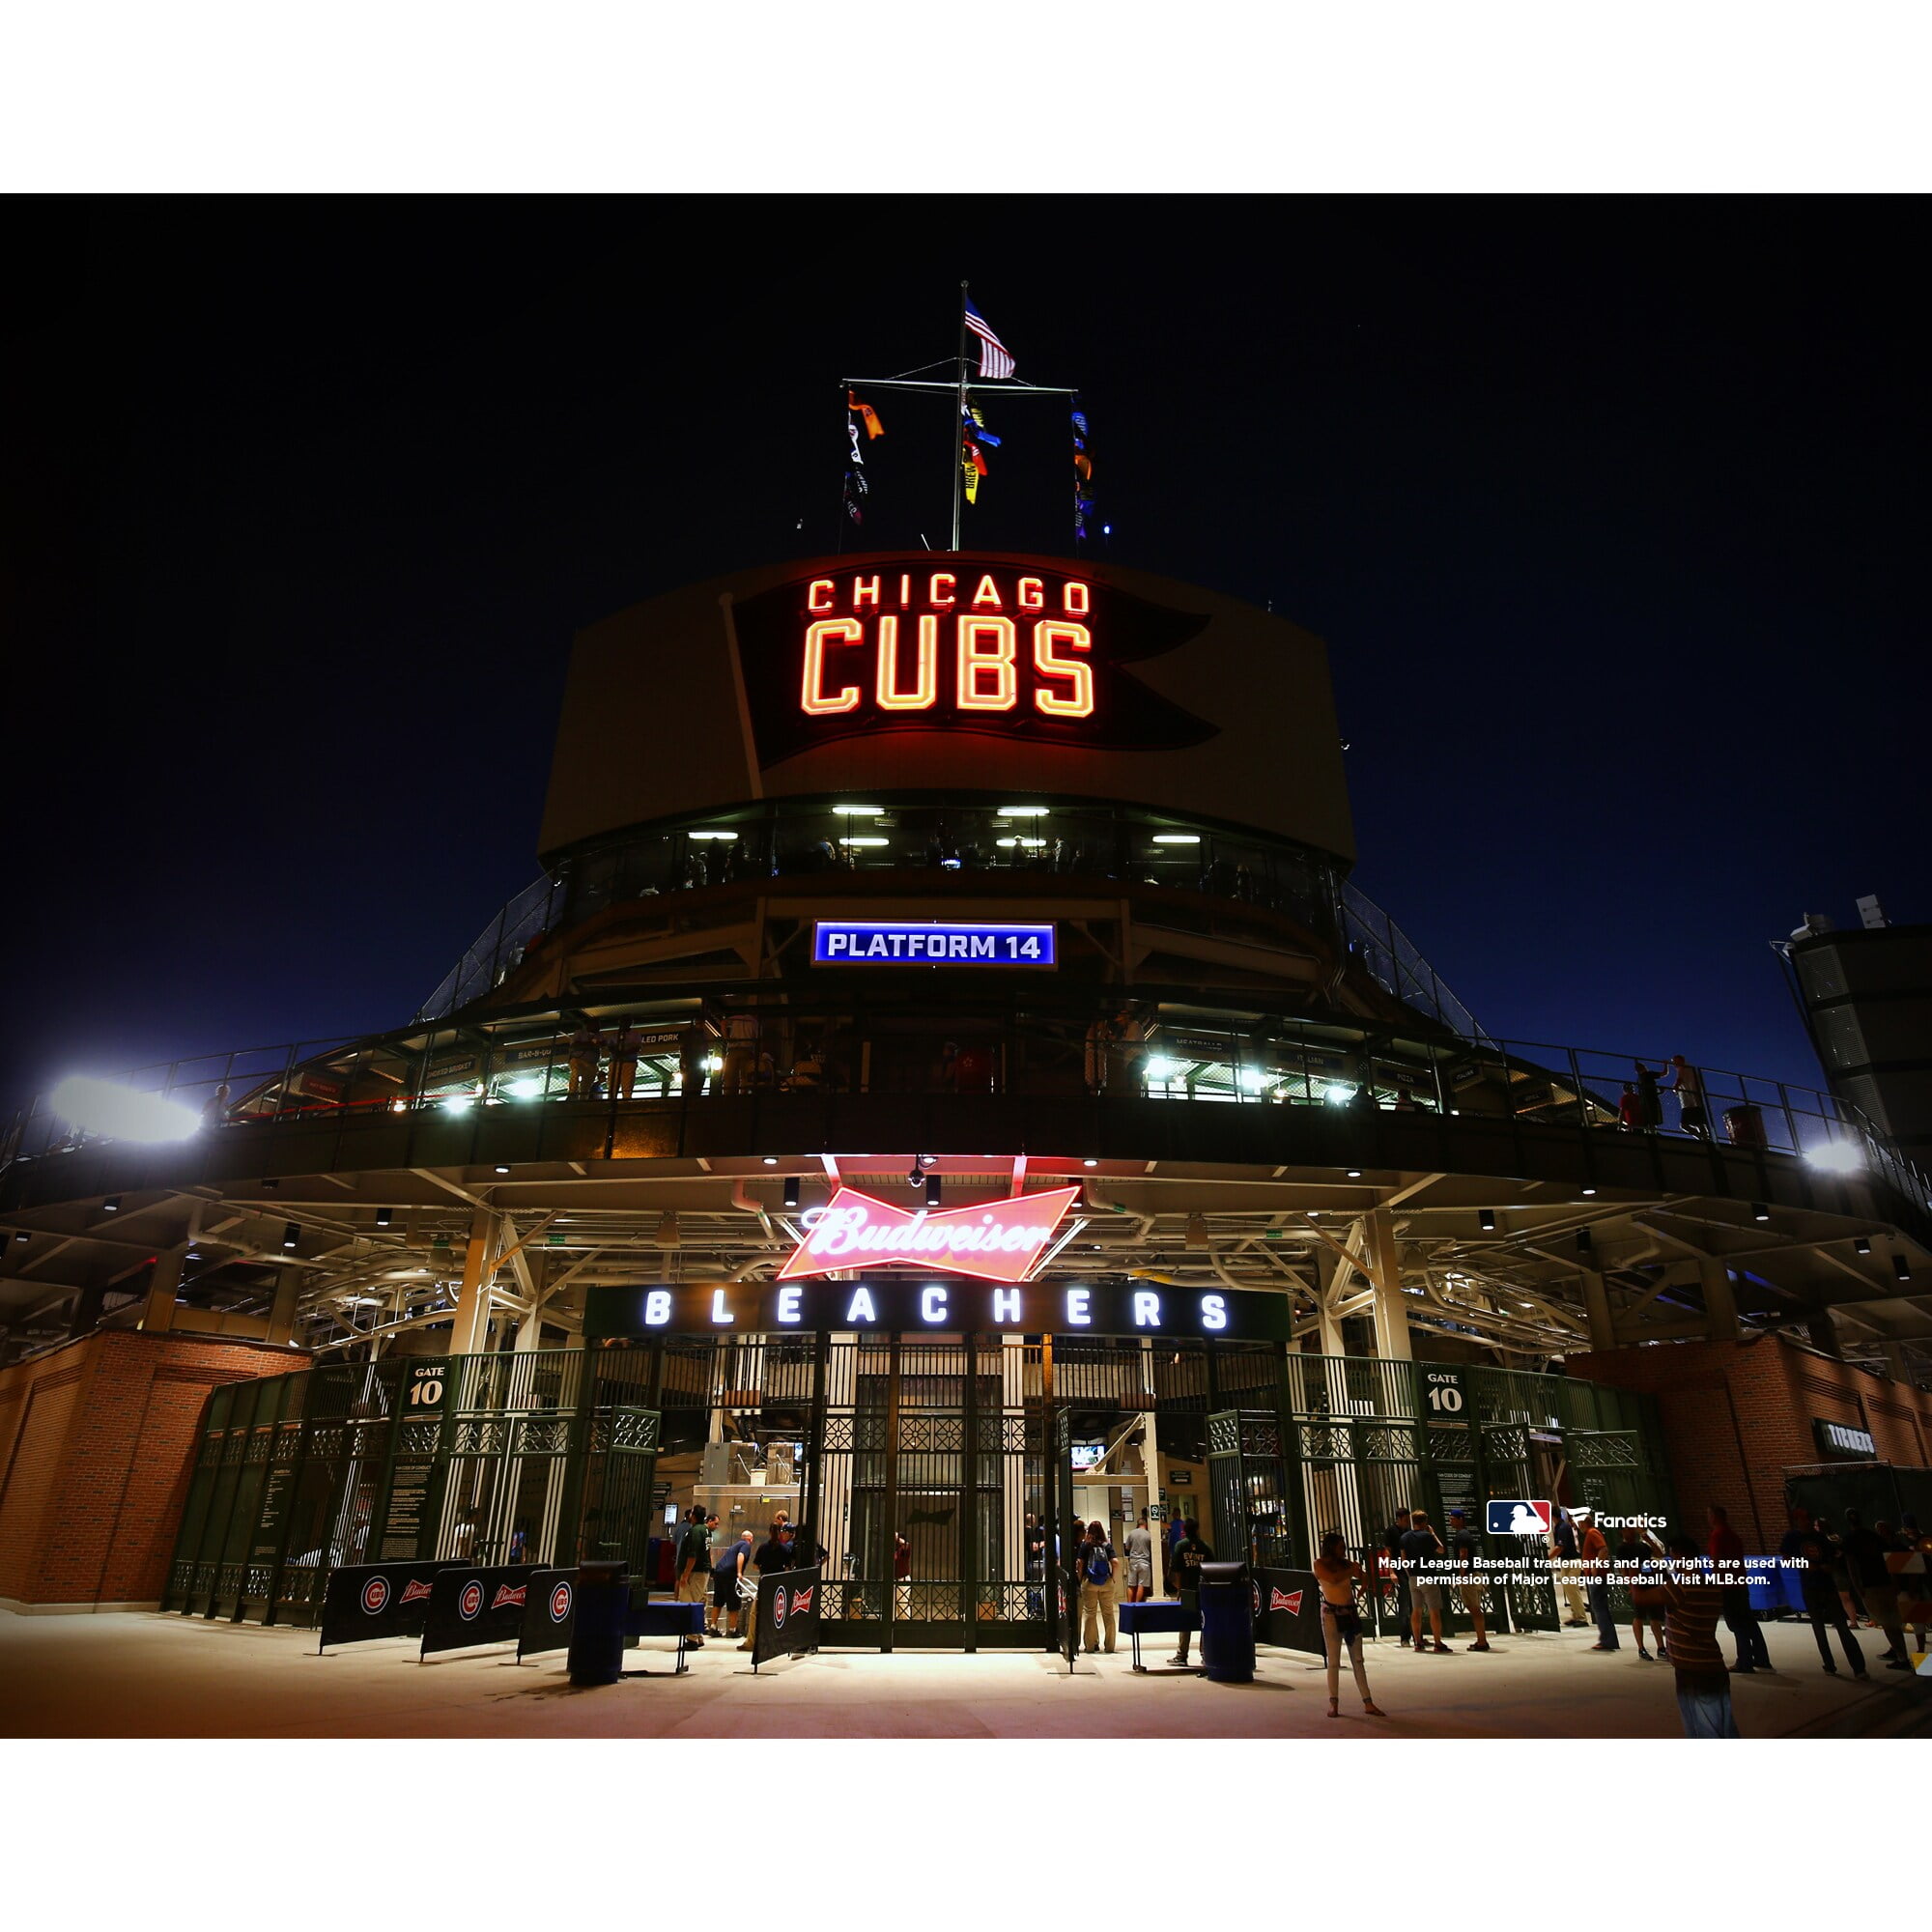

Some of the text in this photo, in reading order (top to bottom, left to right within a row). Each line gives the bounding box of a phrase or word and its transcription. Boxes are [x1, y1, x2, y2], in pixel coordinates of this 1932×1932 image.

[808, 574, 1090, 615] CHICAGO
[802, 615, 1094, 718] CUBS
[828, 932, 1041, 959] PLATFORM 14
[801, 1206, 1051, 1255] Budweiser
[645, 1287, 1228, 1330] BLEACHERS
[414, 1367, 445, 1378] GATE
[1427, 1373, 1459, 1384] GATE
[410, 1379, 443, 1406] 10
[1429, 1386, 1463, 1412] 10
